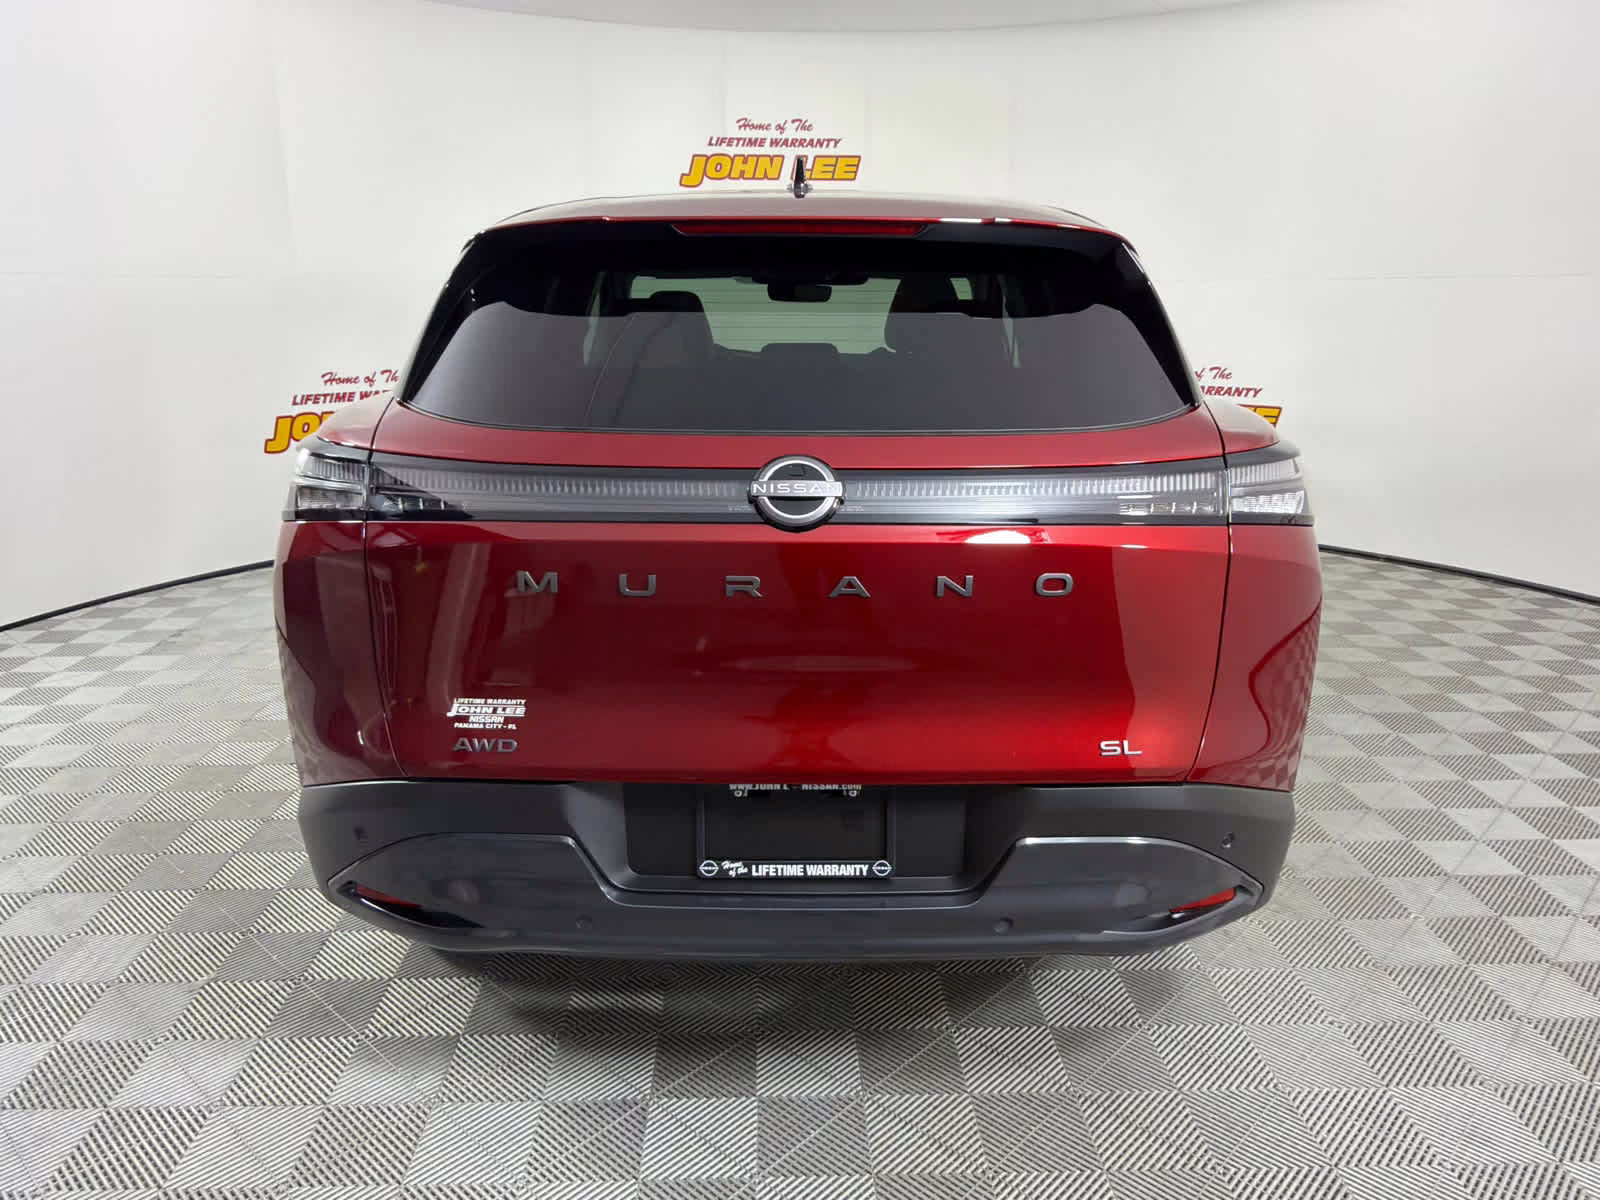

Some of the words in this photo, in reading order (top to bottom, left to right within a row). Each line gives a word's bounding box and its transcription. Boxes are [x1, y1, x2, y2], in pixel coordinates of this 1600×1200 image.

[736, 117, 771, 132] Home
[775, 119, 788, 135] of
[791, 118, 814, 133] The
[707, 136, 767, 148] LIFETIME
[769, 137, 842, 149] WARRANTY
[679, 153, 785, 188] JOHN
[321, 371, 361, 386] Home
[363, 371, 376, 387] of
[380, 369, 400, 384] Th
[1209, 366, 1233, 380] The
[291, 391, 356, 407] LIFETIME
[752, 482, 841, 494] NISSAN
[516, 570, 1076, 598] MURANO
[446, 703, 493, 717] JOHN
[497, 707, 526, 715] LEE
[452, 737, 519, 753] AWD
[1100, 740, 1143, 756] SL
[751, 864, 804, 877] LIFETIME
[806, 864, 869, 877] WARRANTY
